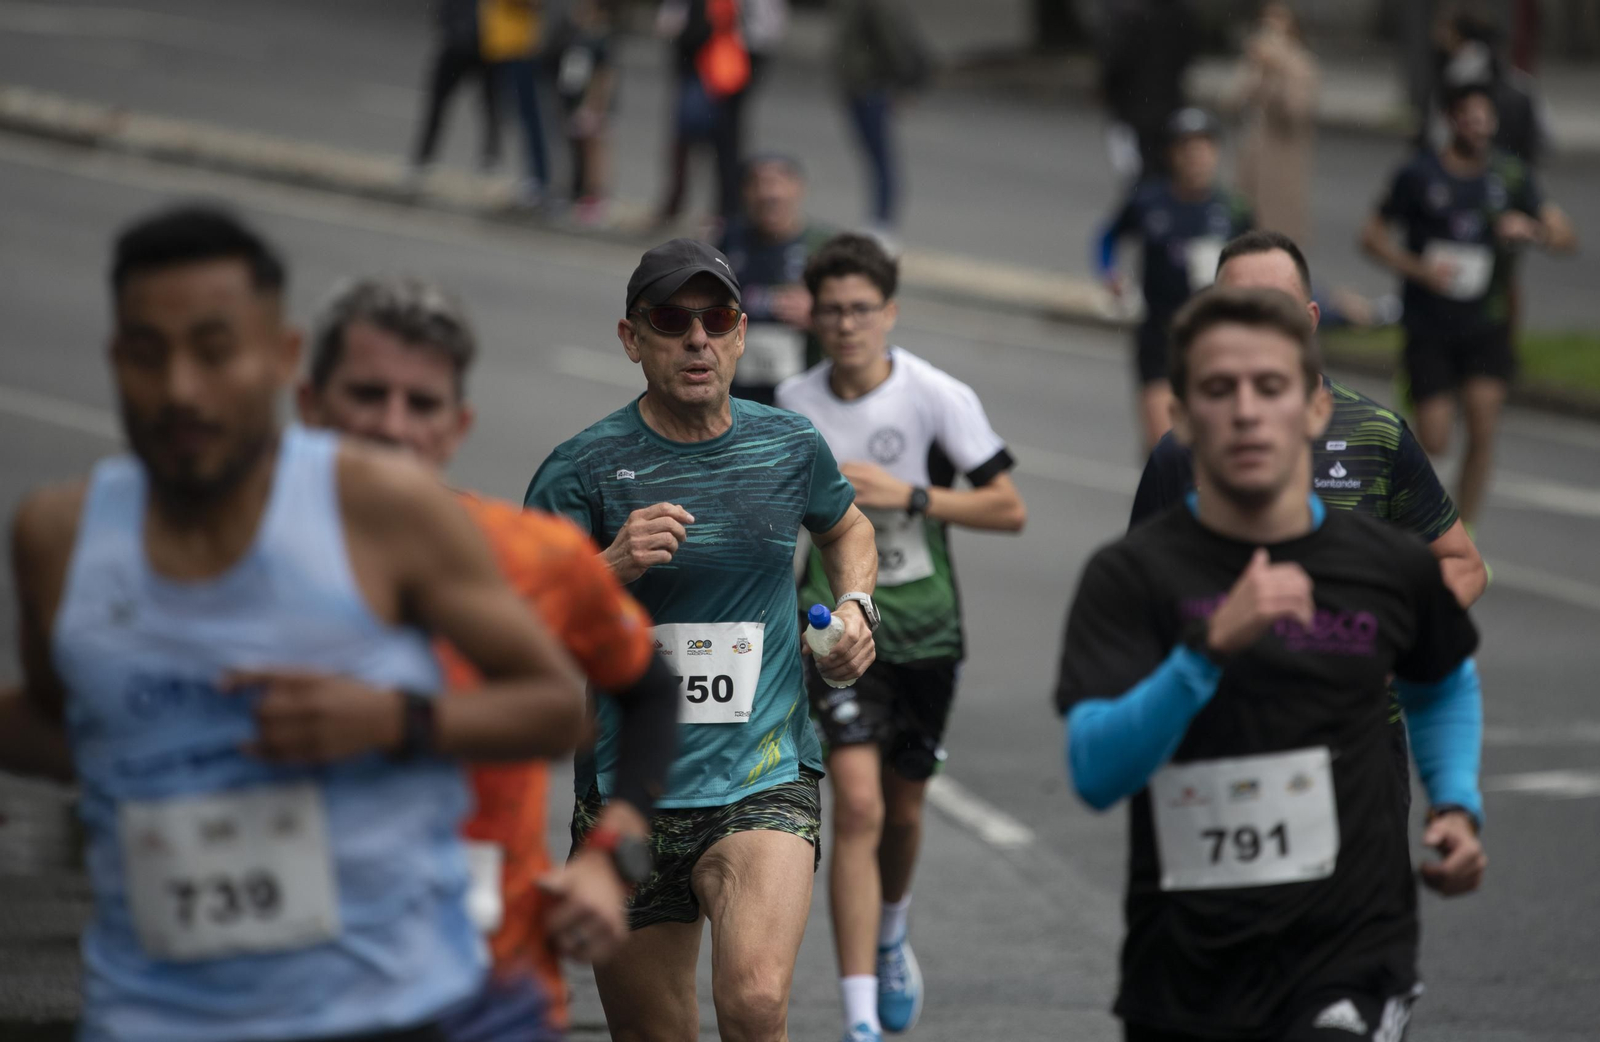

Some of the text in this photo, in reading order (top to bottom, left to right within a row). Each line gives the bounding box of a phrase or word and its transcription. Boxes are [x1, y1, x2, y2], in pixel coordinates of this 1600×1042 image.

[1314, 478, 1361, 488] Santander
[687, 639, 712, 649] 200
[1201, 822, 1291, 865] 791
[167, 869, 283, 931] 739
